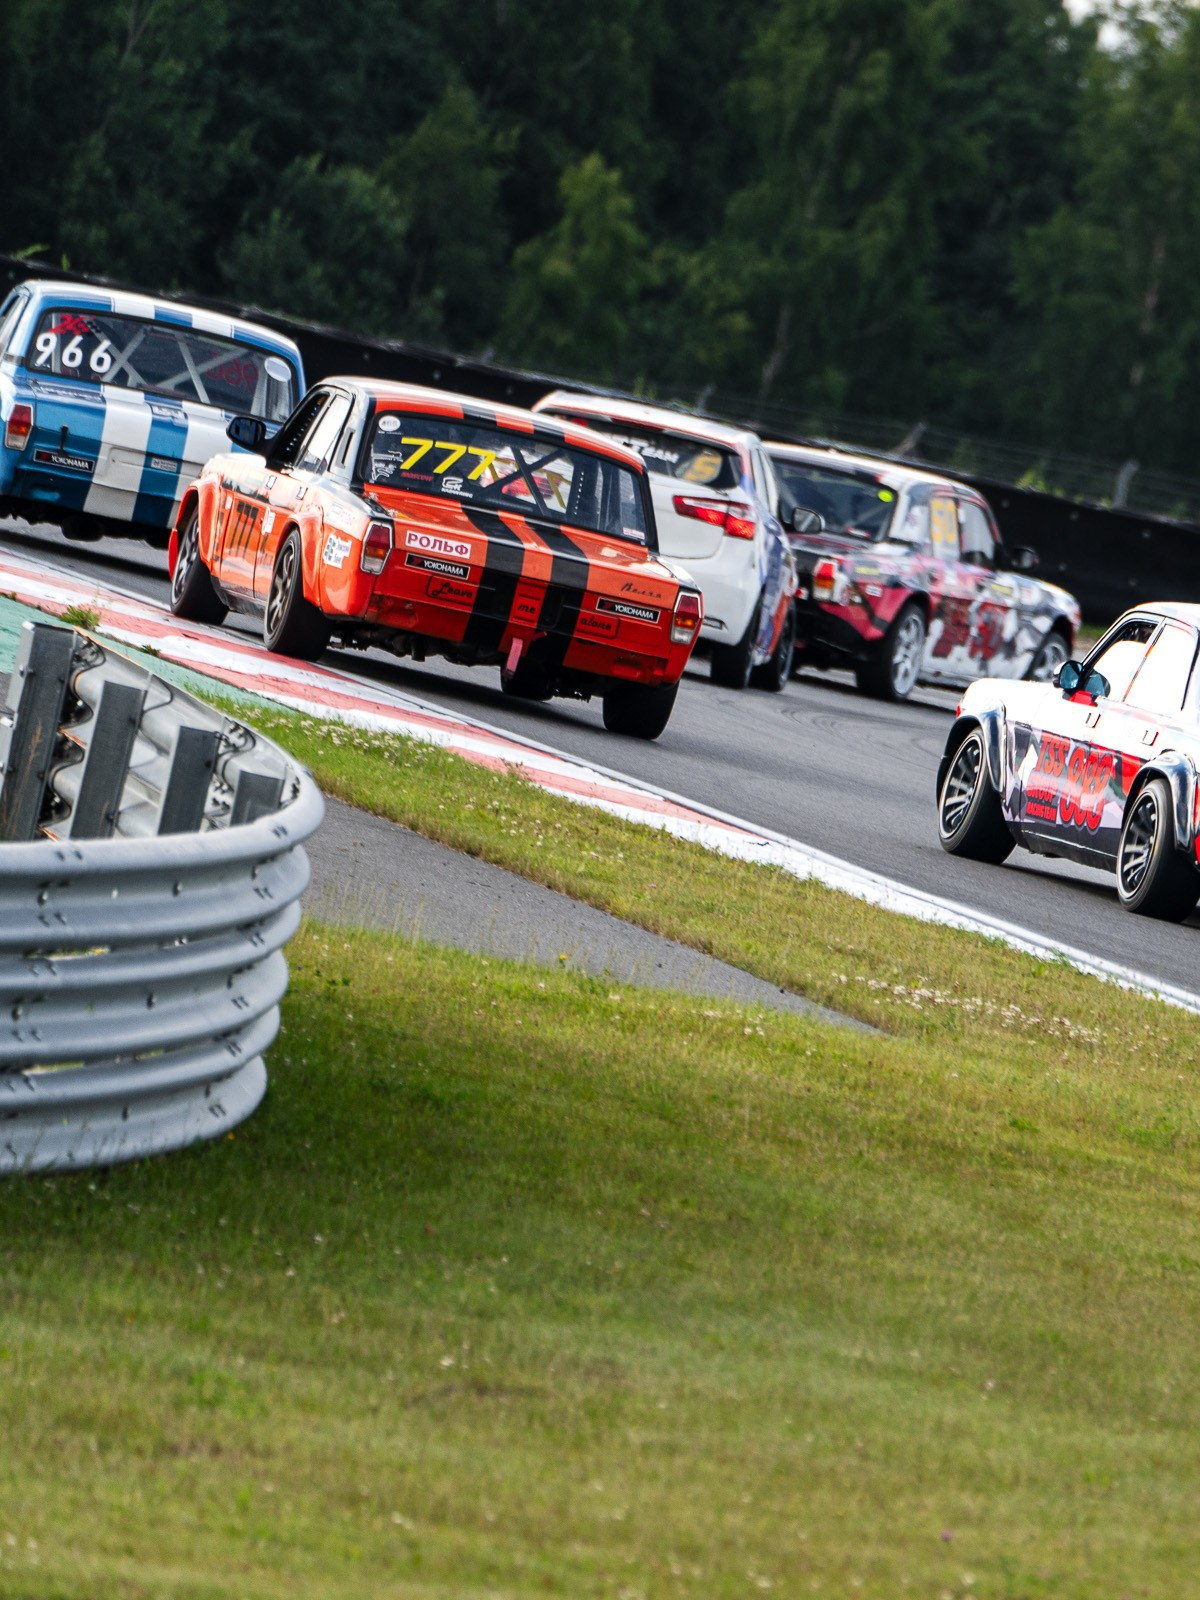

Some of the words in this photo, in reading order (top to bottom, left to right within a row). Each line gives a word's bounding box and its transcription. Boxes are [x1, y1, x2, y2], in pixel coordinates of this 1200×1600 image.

[35, 332, 112, 374] 966
[51, 454, 89, 469] YOKOHAMA
[400, 436, 496, 480] 777
[228, 500, 259, 561] 777
[407, 532, 469, 556] РОЛЬФ
[423, 560, 464, 576] YOKOHAMA
[431, 582, 473, 599] Leave
[517, 603, 536, 615] me
[580, 616, 612, 632] alone
[614, 604, 654, 620] YOKOHAMA
[1034, 734, 1071, 778] TSS
[1060, 746, 1114, 831] 888
